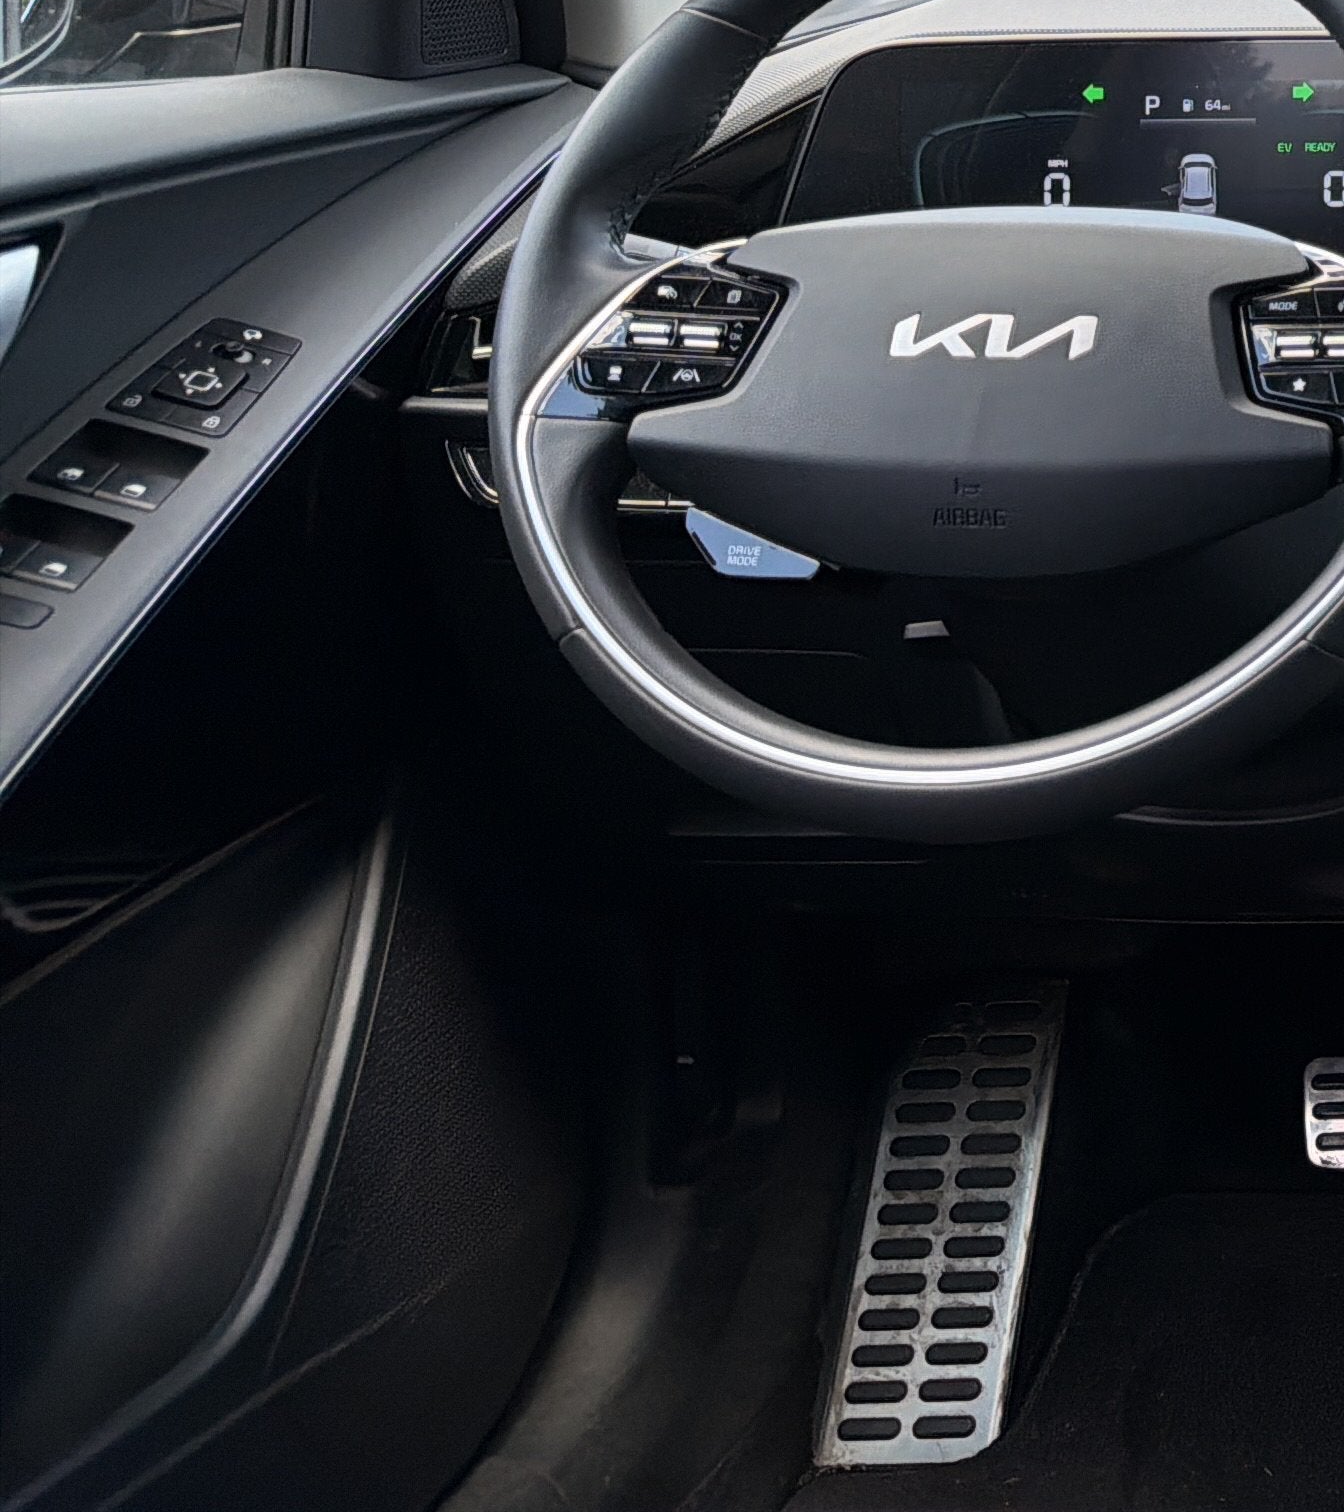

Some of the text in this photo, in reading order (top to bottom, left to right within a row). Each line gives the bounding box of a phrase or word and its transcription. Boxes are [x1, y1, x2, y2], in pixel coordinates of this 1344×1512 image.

[1145, 96, 1161, 115] P
[1205, 99, 1221, 112] 64
[1277, 142, 1337, 153] EV READY
[1048, 159, 1069, 168] MPH
[1268, 301, 1298, 311] MODE
[932, 507, 1009, 527] AIRBAG
[727, 544, 762, 557] DRIVE
[726, 555, 759, 567] MODE
